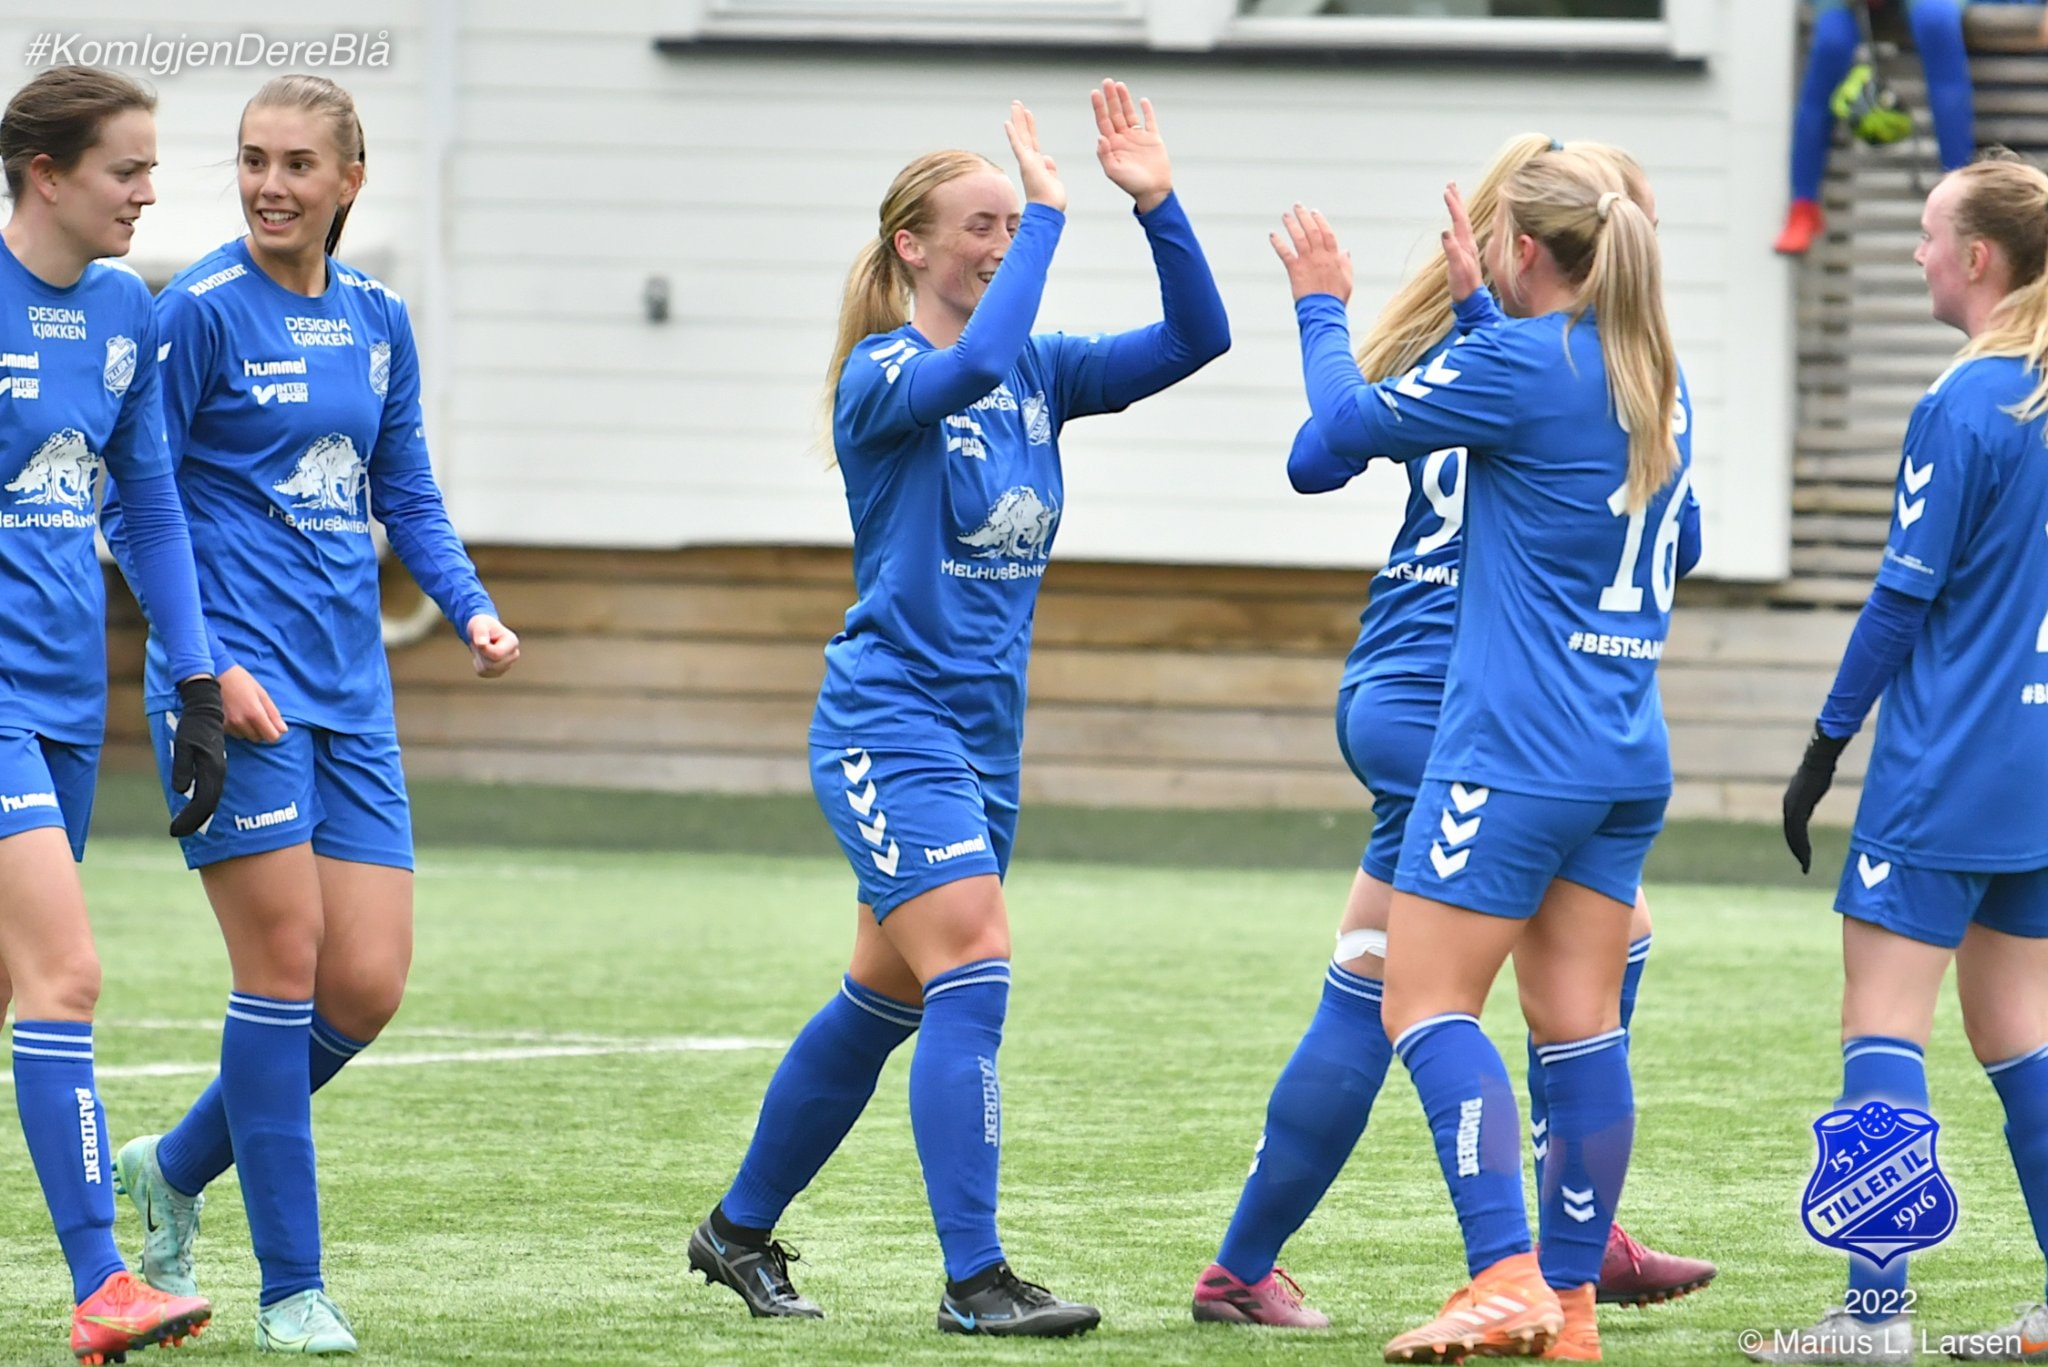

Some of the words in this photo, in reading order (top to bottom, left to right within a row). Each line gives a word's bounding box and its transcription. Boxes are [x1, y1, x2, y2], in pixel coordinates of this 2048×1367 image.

[32, 322, 86, 340] KJØKKEN
[291, 332, 355, 348] KJØKKEN
[243, 356, 307, 377] hummel
[1422, 446, 1468, 556] 9
[1598, 466, 1692, 613] 16
[234, 801, 298, 831] hummel
[924, 834, 987, 864] hummel
[977, 1055, 998, 1148] RAMIRENT
[75, 1087, 102, 1184] RAMIRENT
